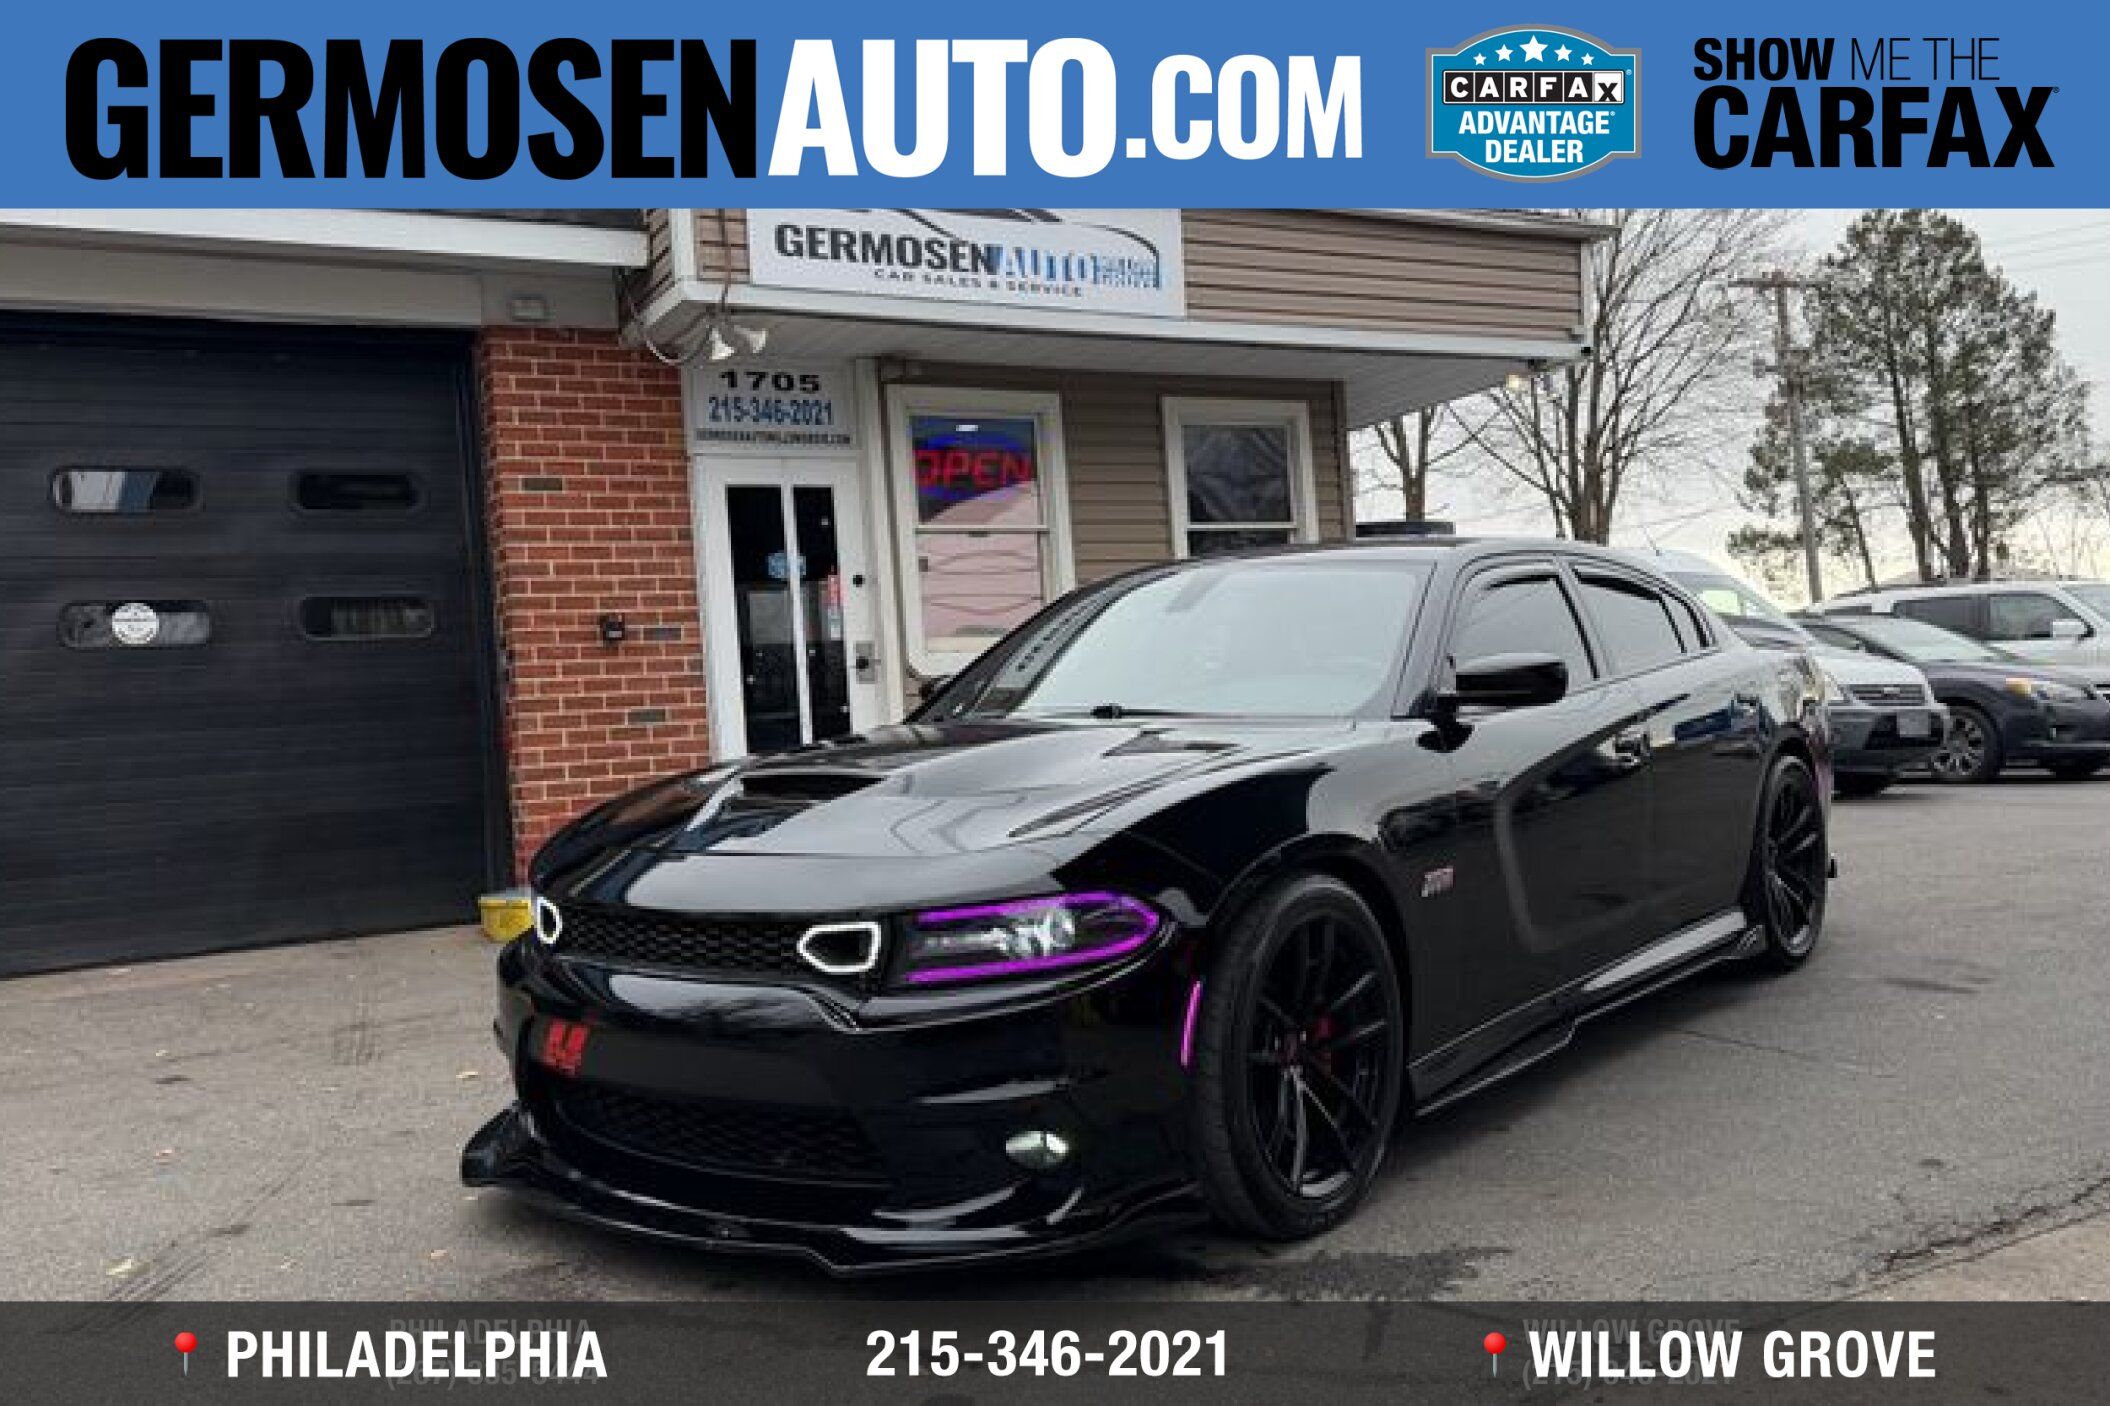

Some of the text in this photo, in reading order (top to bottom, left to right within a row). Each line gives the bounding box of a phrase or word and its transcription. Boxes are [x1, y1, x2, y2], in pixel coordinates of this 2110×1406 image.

[874, 267, 915, 282] CAR
[922, 272, 982, 288] SALES
[718, 368, 821, 393] 1705
[708, 394, 835, 426] 215-346-2021
[912, 447, 1032, 487] OPEN
